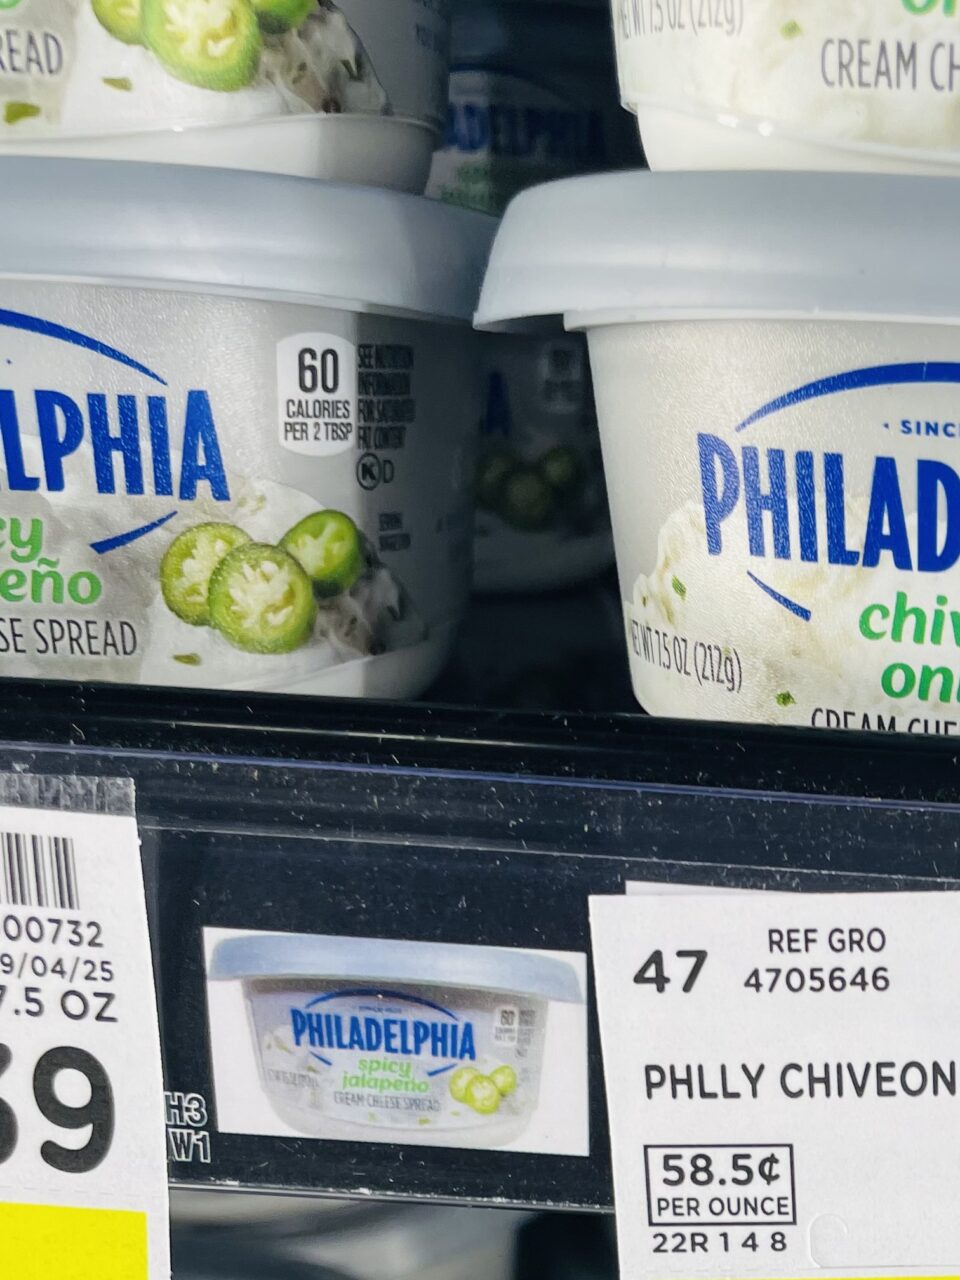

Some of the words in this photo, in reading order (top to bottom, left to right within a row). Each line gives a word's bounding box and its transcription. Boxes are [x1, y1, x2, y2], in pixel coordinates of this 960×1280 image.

[820, 38, 919, 91] CREAM
[297, 347, 339, 393] 60
[286, 398, 351, 419] CALORIES
[0, 389, 231, 501] LPHIA
[284, 422, 310, 441] PER
[313, 423, 322, 441] 2
[325, 422, 353, 441] TBSP
[0, 517, 43, 563] y
[33, 618, 138, 656] SPREAD
[655, 629, 671, 670] 7.5
[673, 635, 691, 677] OZ
[694, 640, 743, 693] (212g)
[3, 914, 105, 948] 00732
[768, 928, 818, 954] REF
[828, 927, 887, 954] GRO
[1, 953, 115, 983] 9/04/25
[633, 949, 709, 994] 47
[743, 967, 891, 993] 4705646
[60, 989, 119, 1023] OZ
[290, 1008, 477, 1061] PHILADELPHIA
[357, 1058, 413, 1079] spicy
[644, 1063, 765, 1099] PHLLY
[662, 1152, 781, 1187] 58.5¢
[657, 1197, 701, 1218] PER
[708, 1196, 791, 1217] OUNCE
[652, 1231, 709, 1254] 22R
